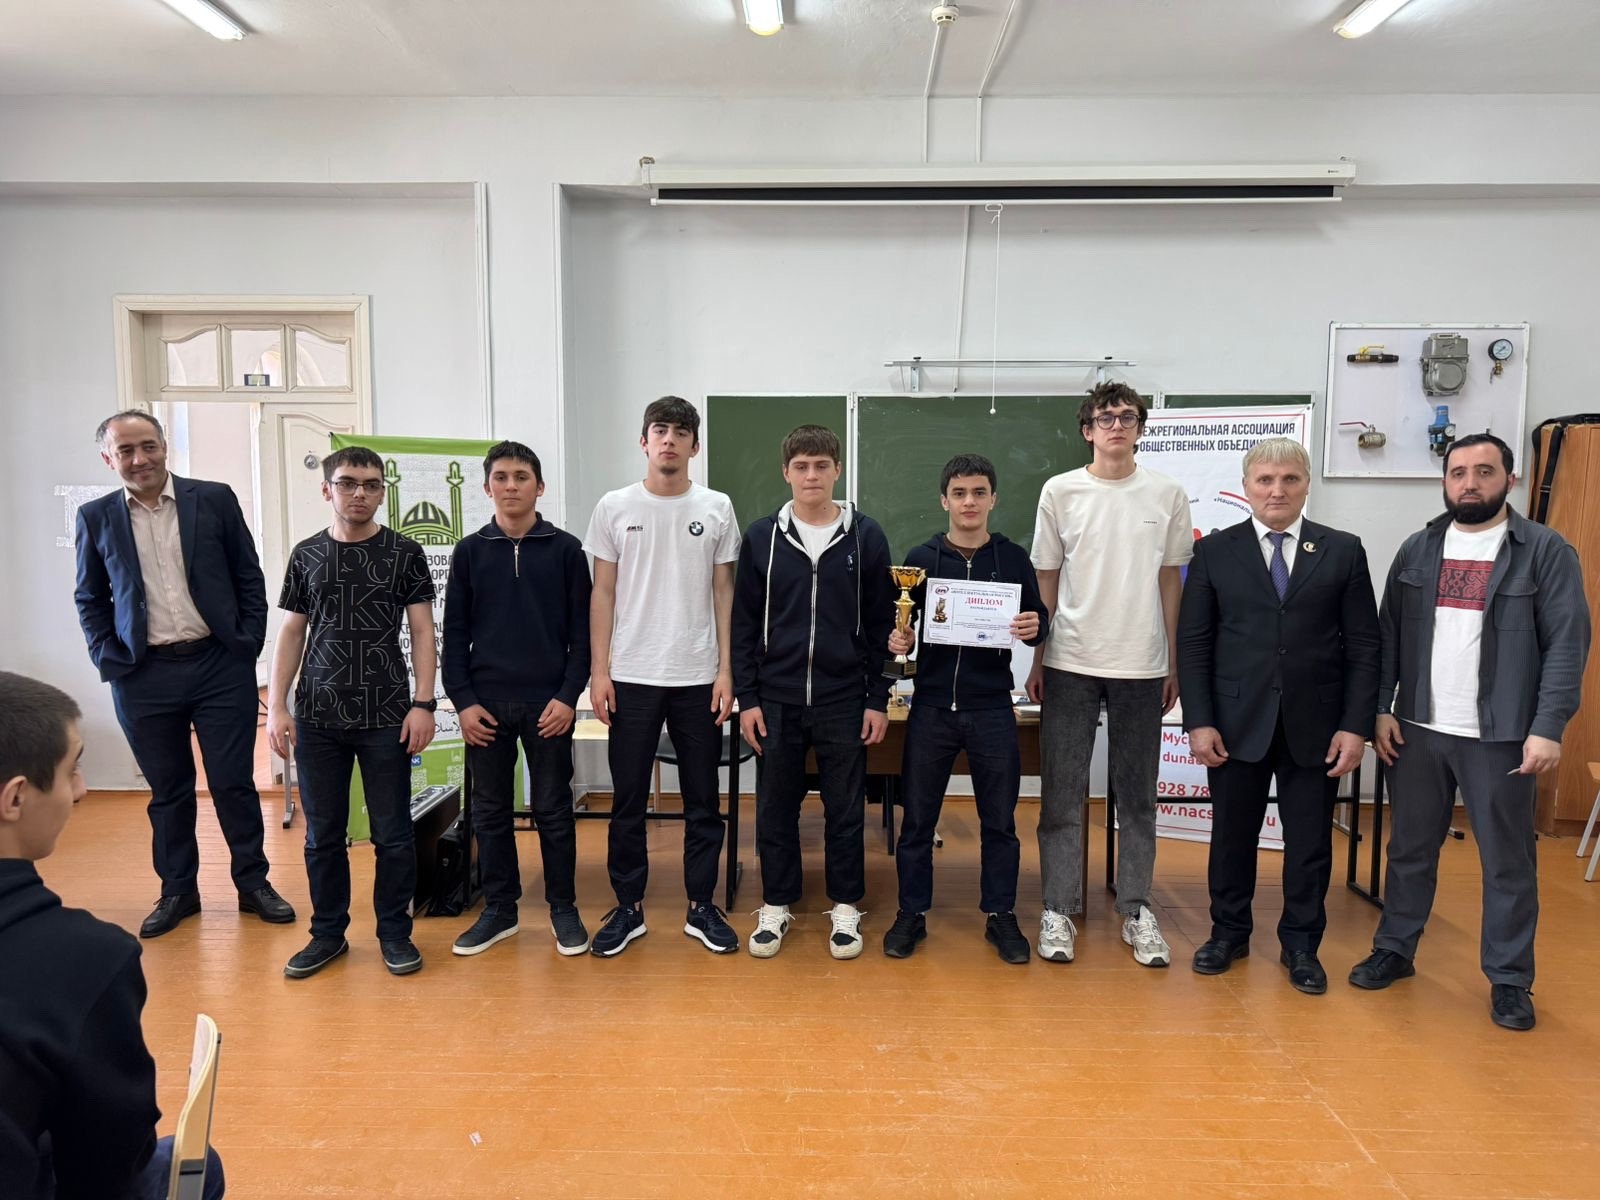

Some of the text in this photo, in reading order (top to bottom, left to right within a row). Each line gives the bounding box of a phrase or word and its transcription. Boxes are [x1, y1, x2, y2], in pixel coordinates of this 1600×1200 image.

[1143, 423, 1295, 437] ЕЖРЕГИОНАЛЬНАЯ АССОЦИАЦИЯ
[1140, 439, 1263, 453] ОБЩЕСТВЕННЫХ ОБЪЕДИ
[1163, 732, 1188, 746] Мус
[1163, 752, 1202, 765] duna
[1158, 781, 1210, 798] 928 78
